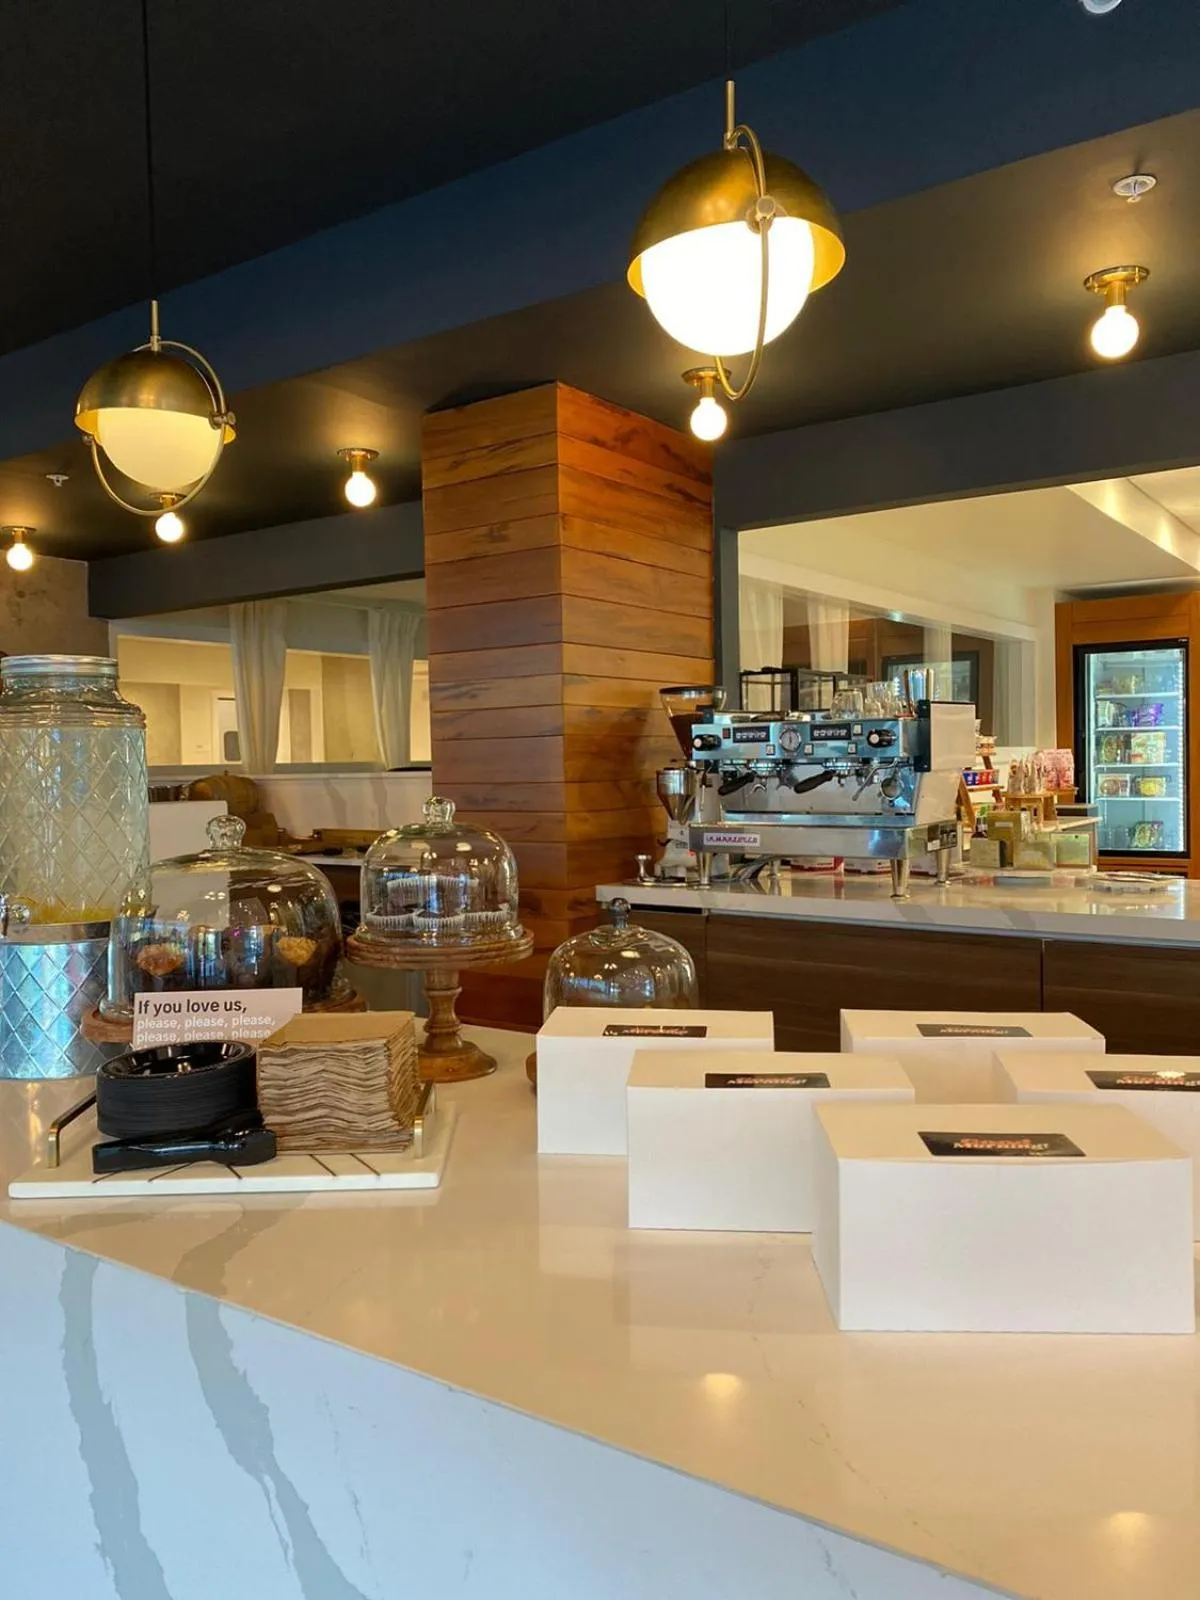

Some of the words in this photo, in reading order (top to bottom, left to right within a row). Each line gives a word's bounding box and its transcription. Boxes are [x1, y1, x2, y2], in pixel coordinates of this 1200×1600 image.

[138, 1000, 150, 1014] If
[153, 1002, 182, 1017] you
[186, 999, 220, 1013] love
[223, 1000, 247, 1014] us,
[136, 1018, 181, 1031] please,
[184, 1016, 228, 1030] please,
[231, 1014, 275, 1029] please,
[136, 1031, 181, 1045] please,
